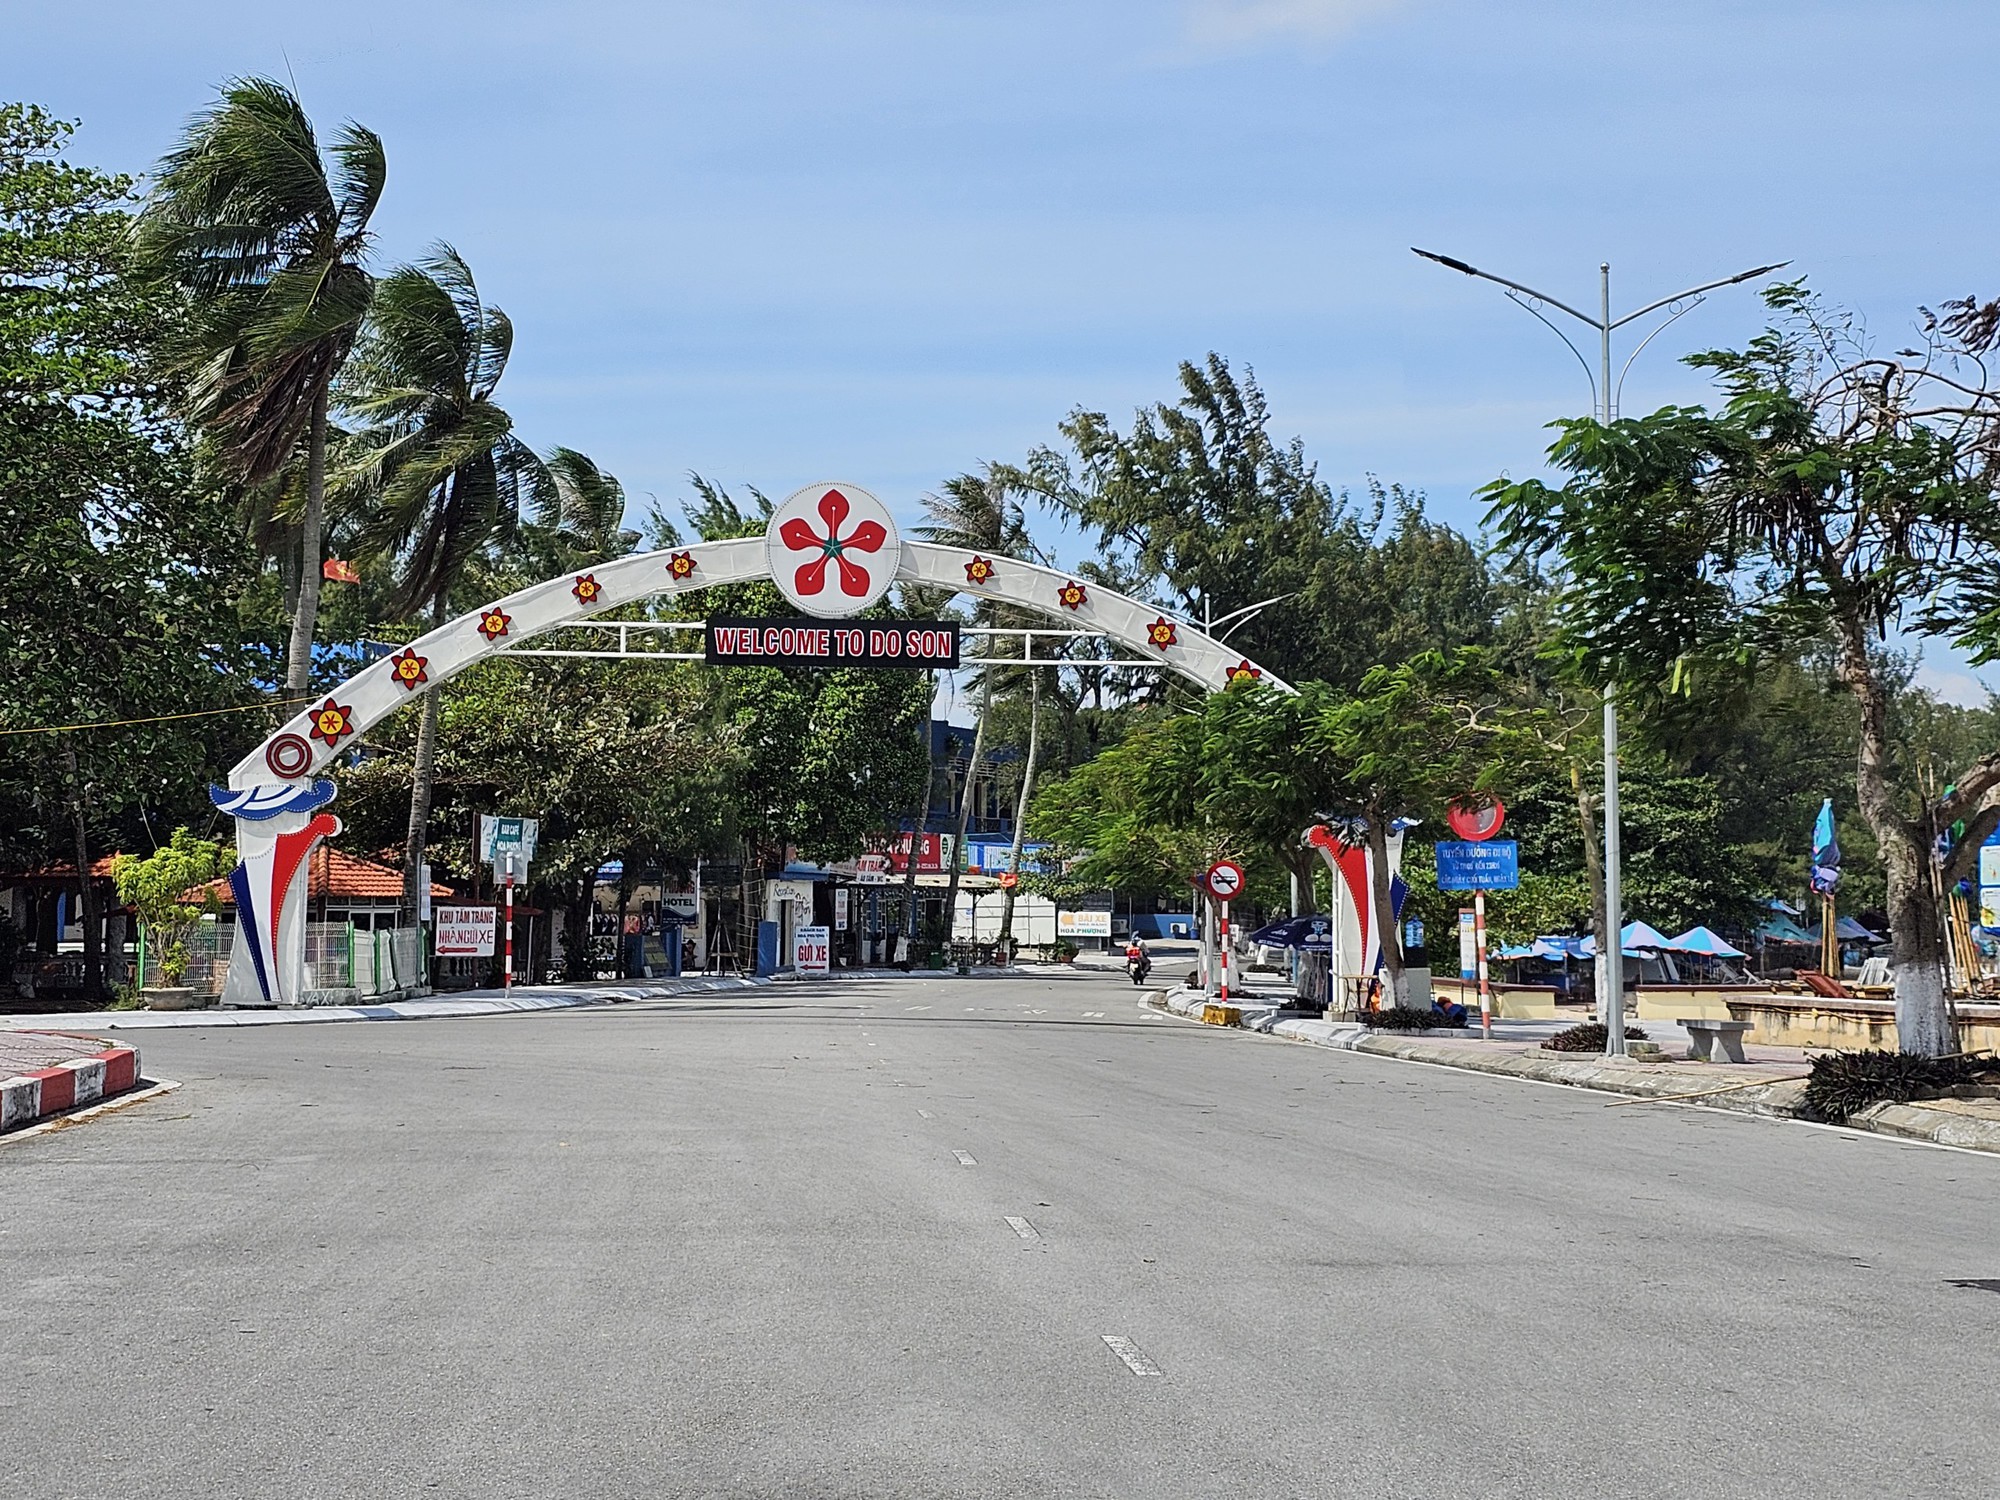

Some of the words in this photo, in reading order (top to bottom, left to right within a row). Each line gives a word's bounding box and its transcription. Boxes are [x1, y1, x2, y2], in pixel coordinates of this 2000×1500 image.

[714, 627, 829, 656] WELCOME
[834, 629, 865, 656] TO
[870, 630, 901, 657] DO
[906, 630, 952, 658] SON
[664, 898, 695, 907] HOTEL
[439, 911, 453, 924] KHU
[456, 908, 470, 924] TẮM
[472, 909, 494, 924] TRÁNG
[1096, 914, 1107, 922] XE
[479, 930, 494, 945] XE
[816, 945, 827, 961] XE
